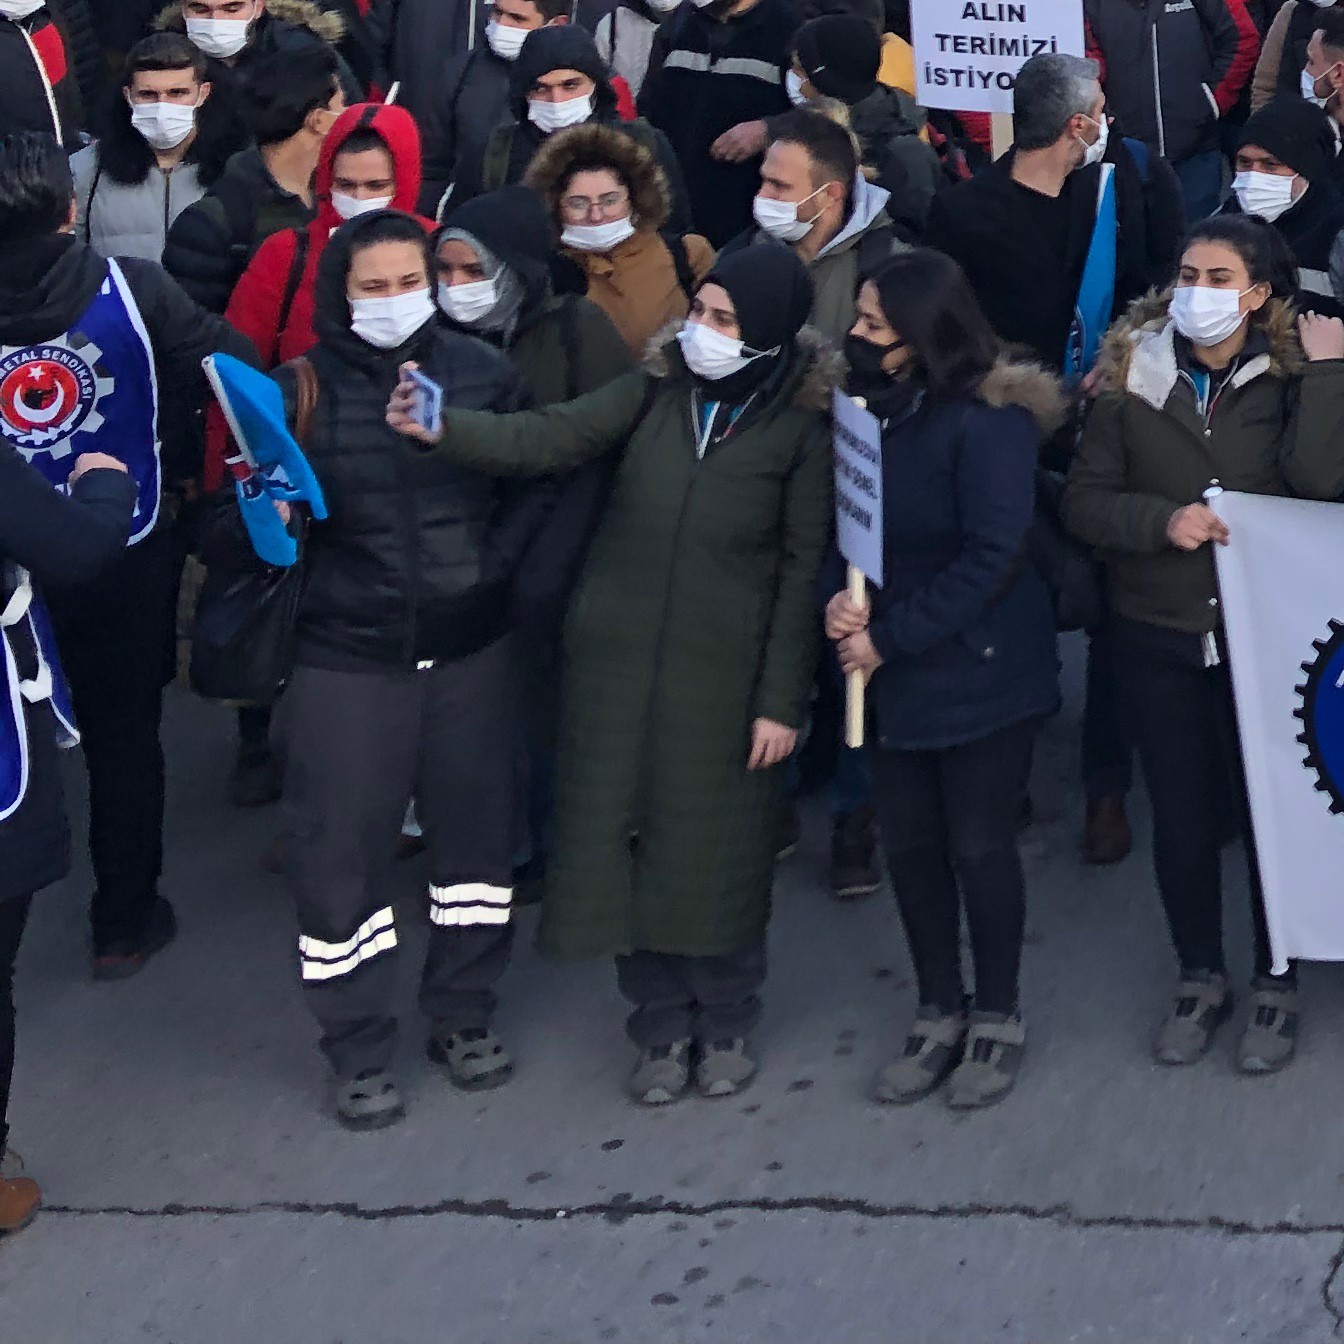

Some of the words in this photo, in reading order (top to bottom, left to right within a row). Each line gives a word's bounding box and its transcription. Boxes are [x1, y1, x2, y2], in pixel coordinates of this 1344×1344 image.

[961, 1, 1026, 22] ALIN
[935, 32, 1058, 57] TERİMİZİ
[925, 61, 1014, 90] İSTİYO
